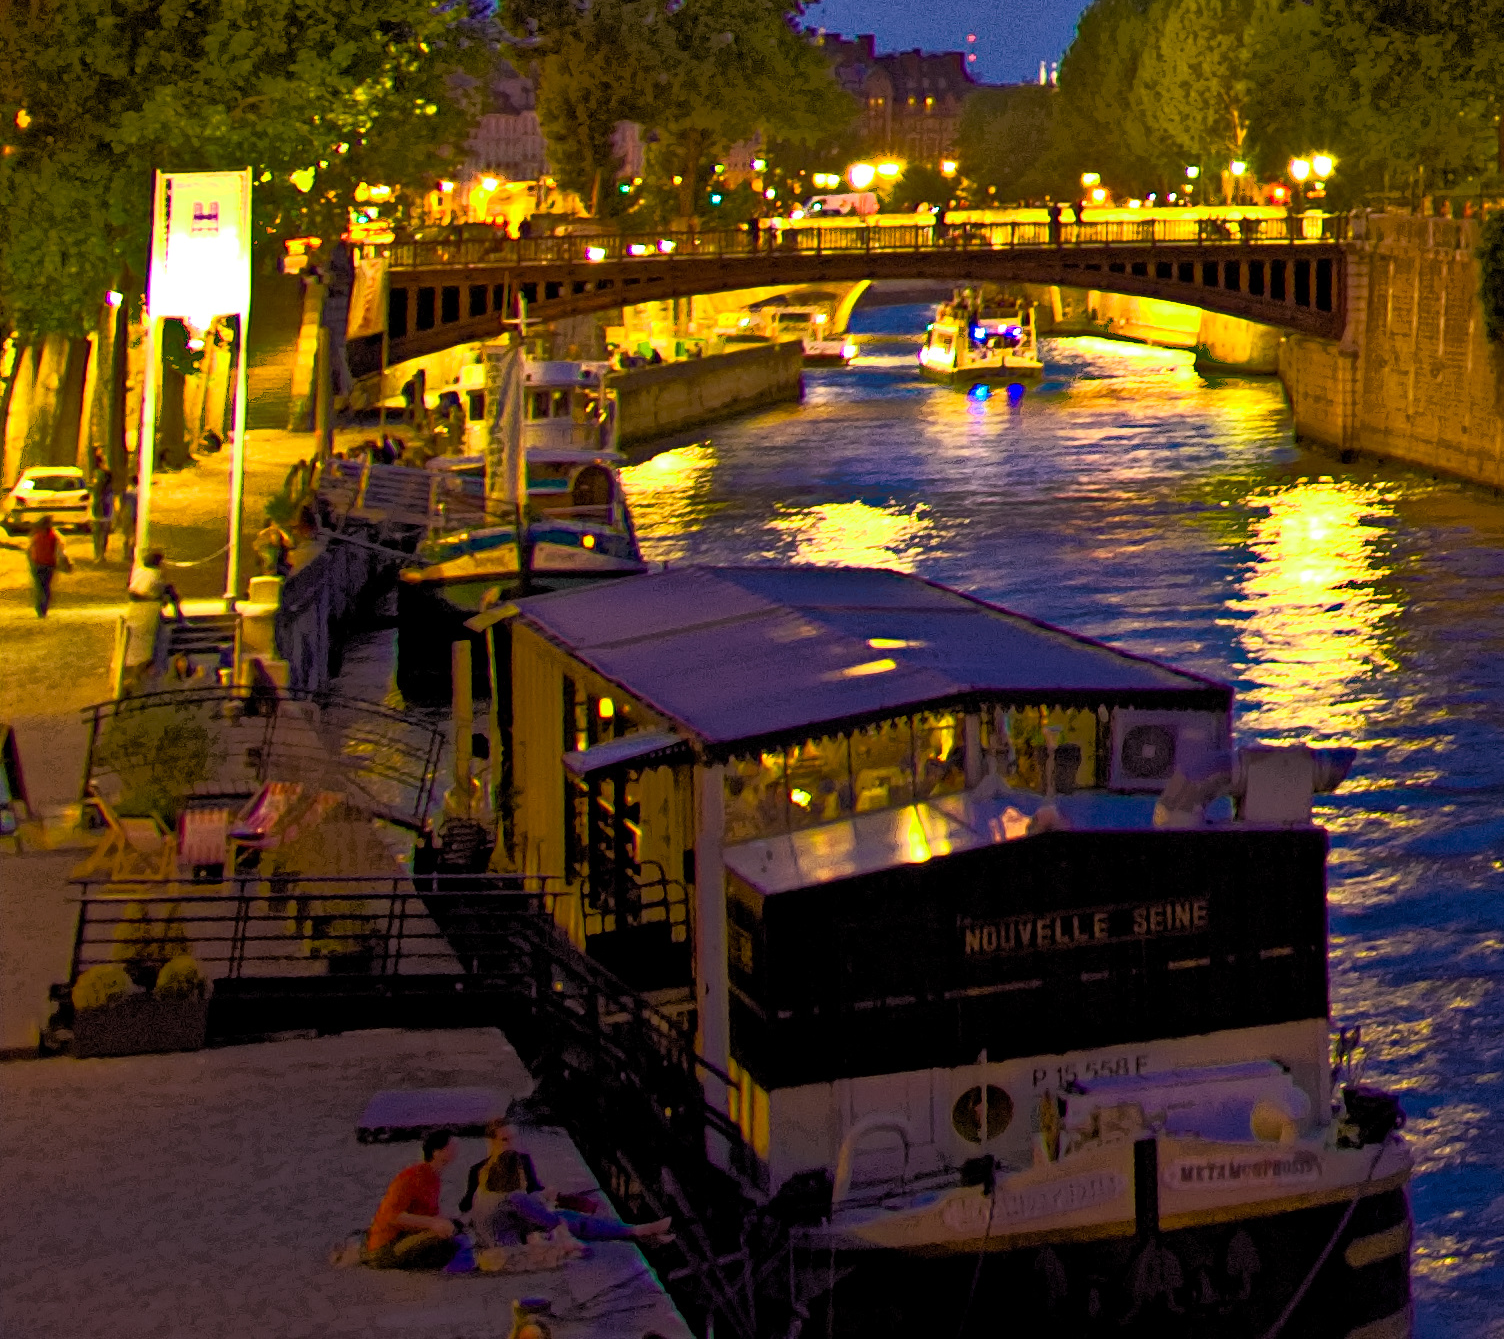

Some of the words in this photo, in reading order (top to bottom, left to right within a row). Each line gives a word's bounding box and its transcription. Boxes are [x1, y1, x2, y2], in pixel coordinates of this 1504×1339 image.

[964, 912, 1109, 955] NOUVELLE
[1131, 900, 1210, 935] SEINE
[1032, 1068, 1047, 1088] P
